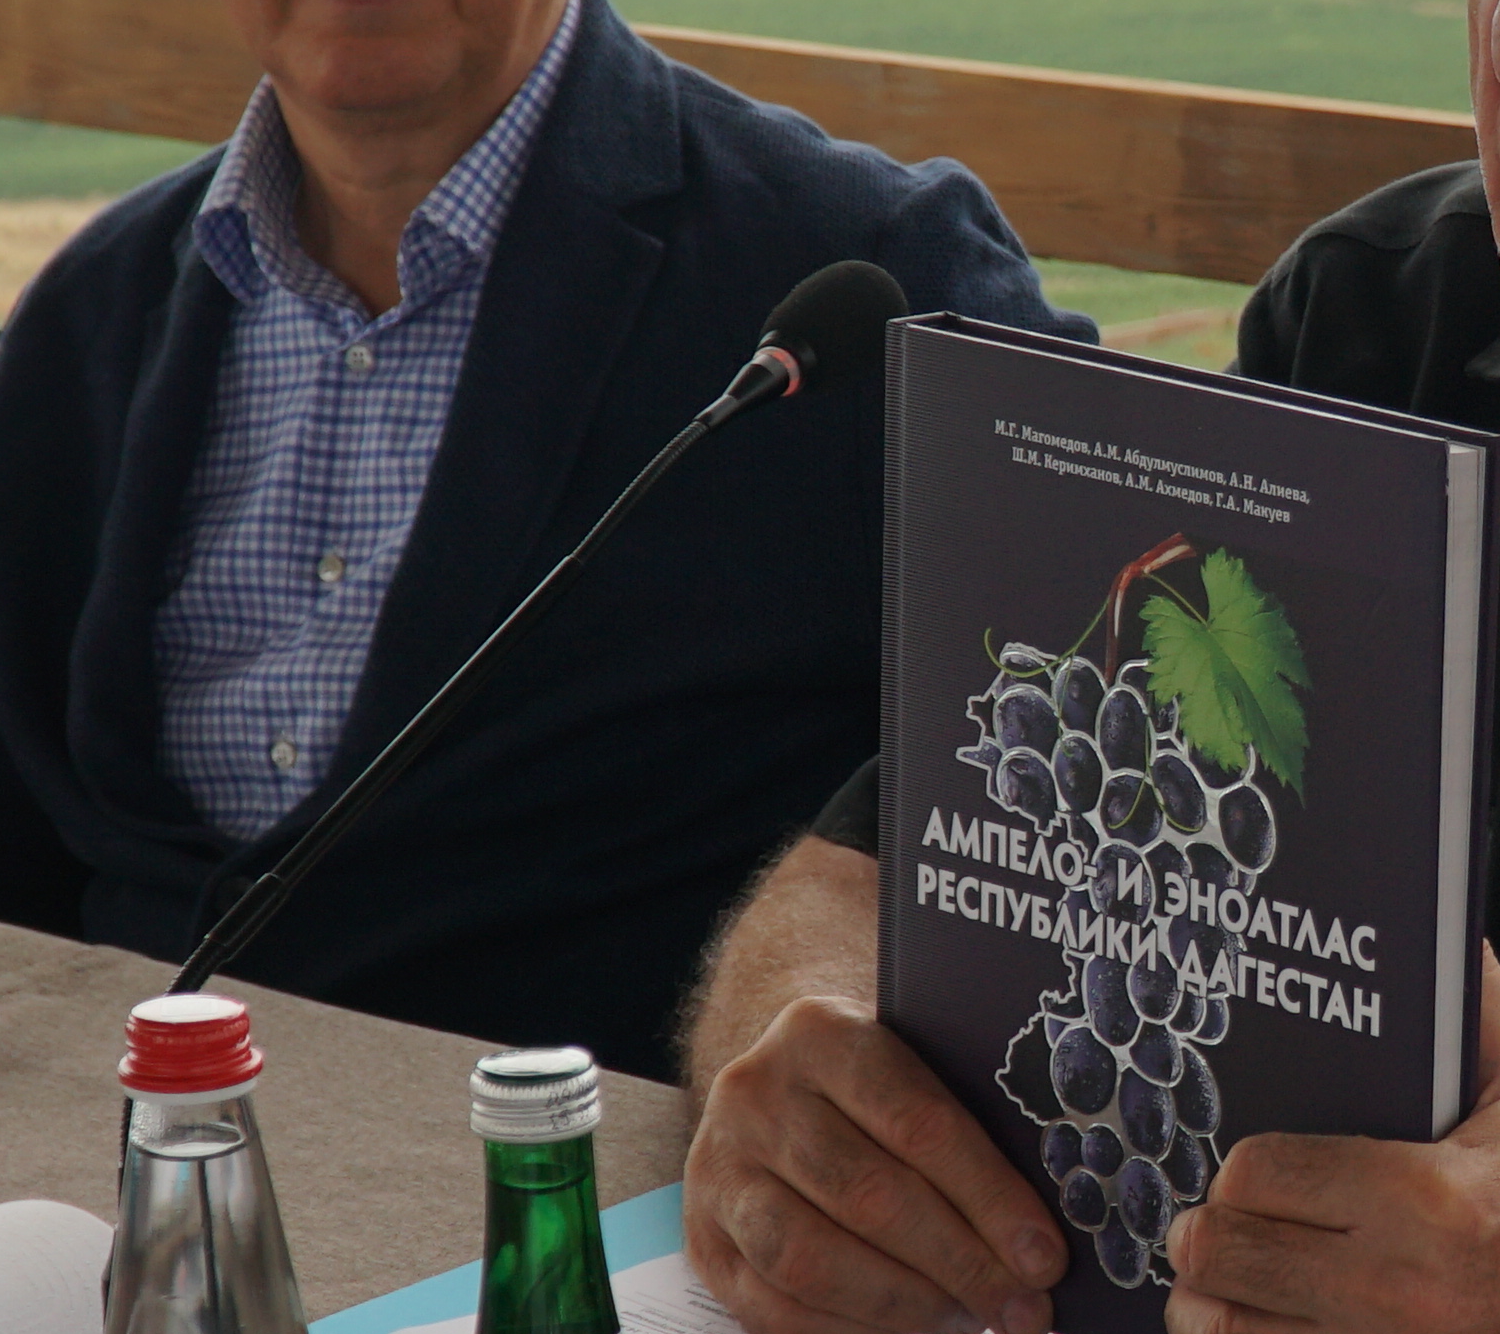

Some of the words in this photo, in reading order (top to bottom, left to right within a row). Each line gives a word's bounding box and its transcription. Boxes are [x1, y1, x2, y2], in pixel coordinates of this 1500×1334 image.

[1093, 442, 1122, 462] А.М.
[1259, 478, 1311, 505] Алиева,
[1125, 471, 1153, 493] А.М.
[921, 805, 1098, 888] АМПЕЛО-
[1116, 857, 1143, 907] И
[1163, 870, 1377, 973] ЭНОАТЛАС
[916, 862, 1159, 972] РЕСПУБЛИКИ
[1176, 938, 1381, 1038] ДАГЕСТАН
